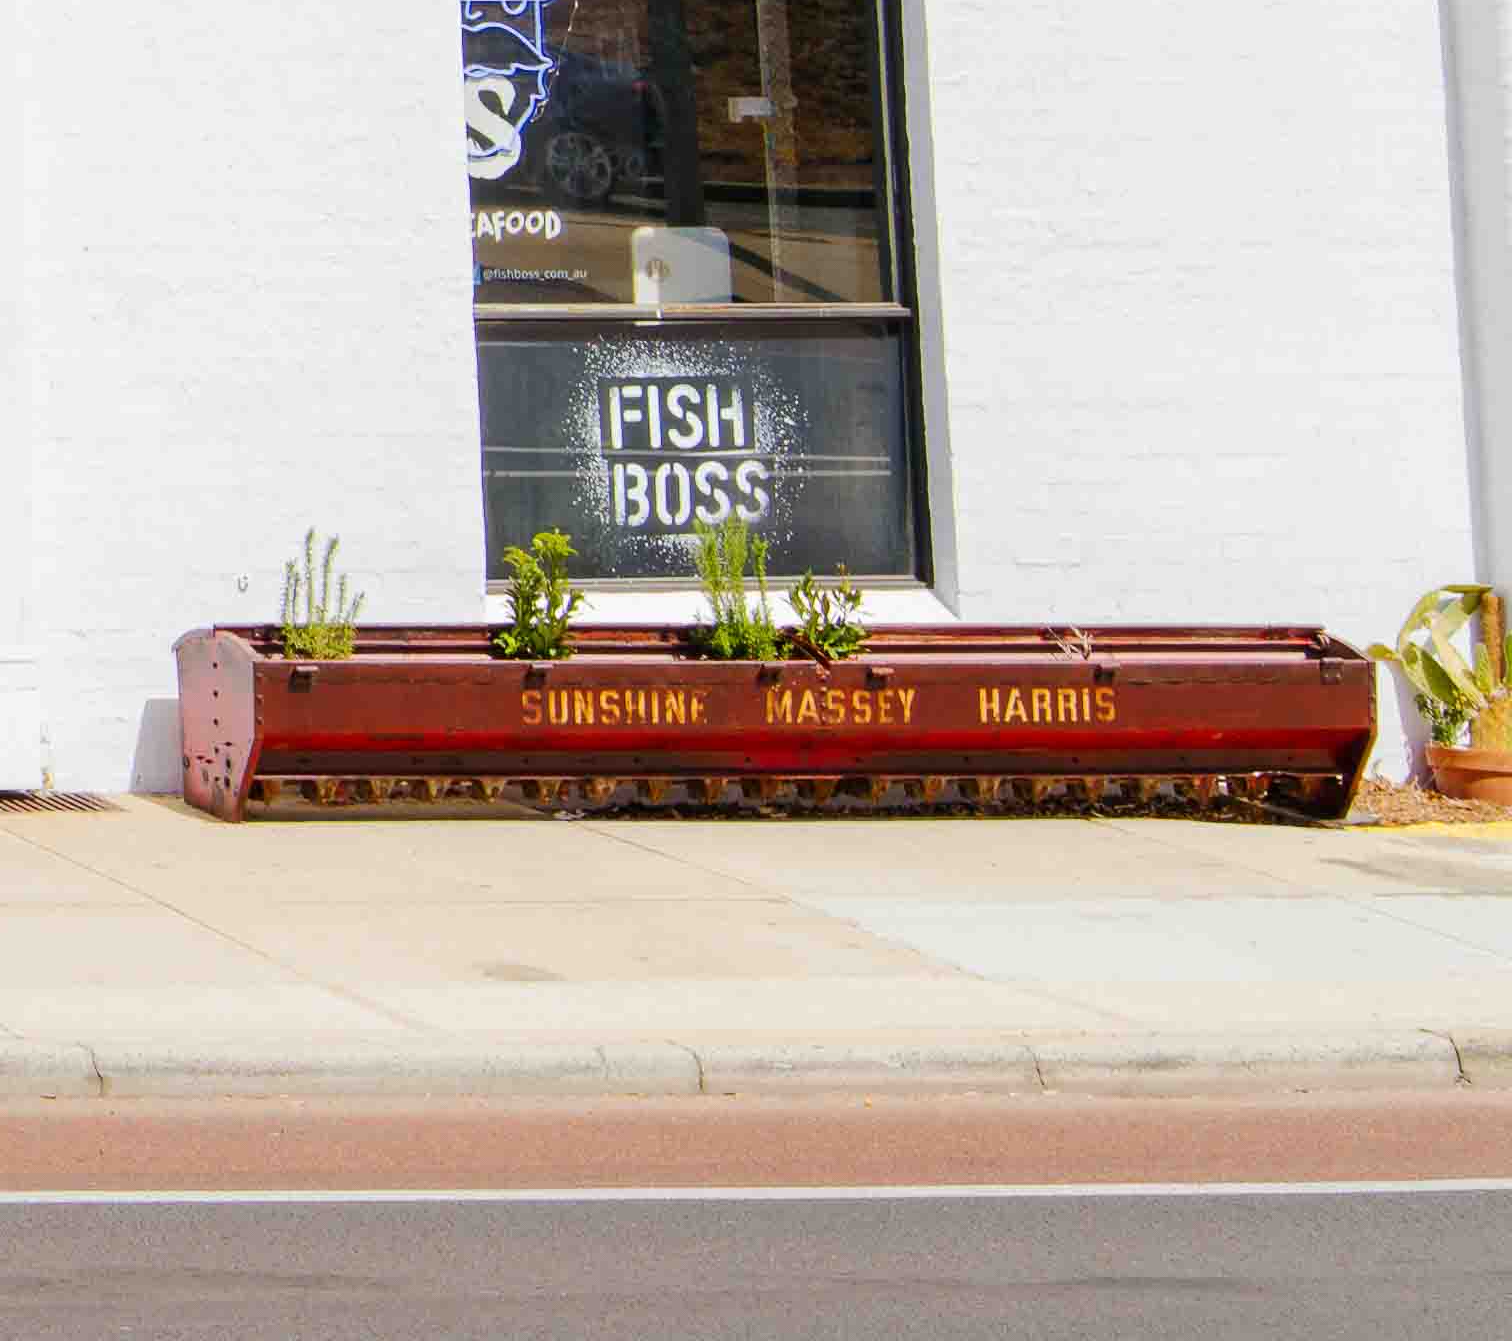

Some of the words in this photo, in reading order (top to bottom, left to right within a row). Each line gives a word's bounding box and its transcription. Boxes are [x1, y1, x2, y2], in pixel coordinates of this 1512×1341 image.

[608, 383, 745, 450] FISH
[613, 459, 771, 527] BOSS
[520, 689, 709, 726] SUNSHINE
[765, 687, 916, 725] MASSEY
[978, 687, 1117, 725] HARRIS
